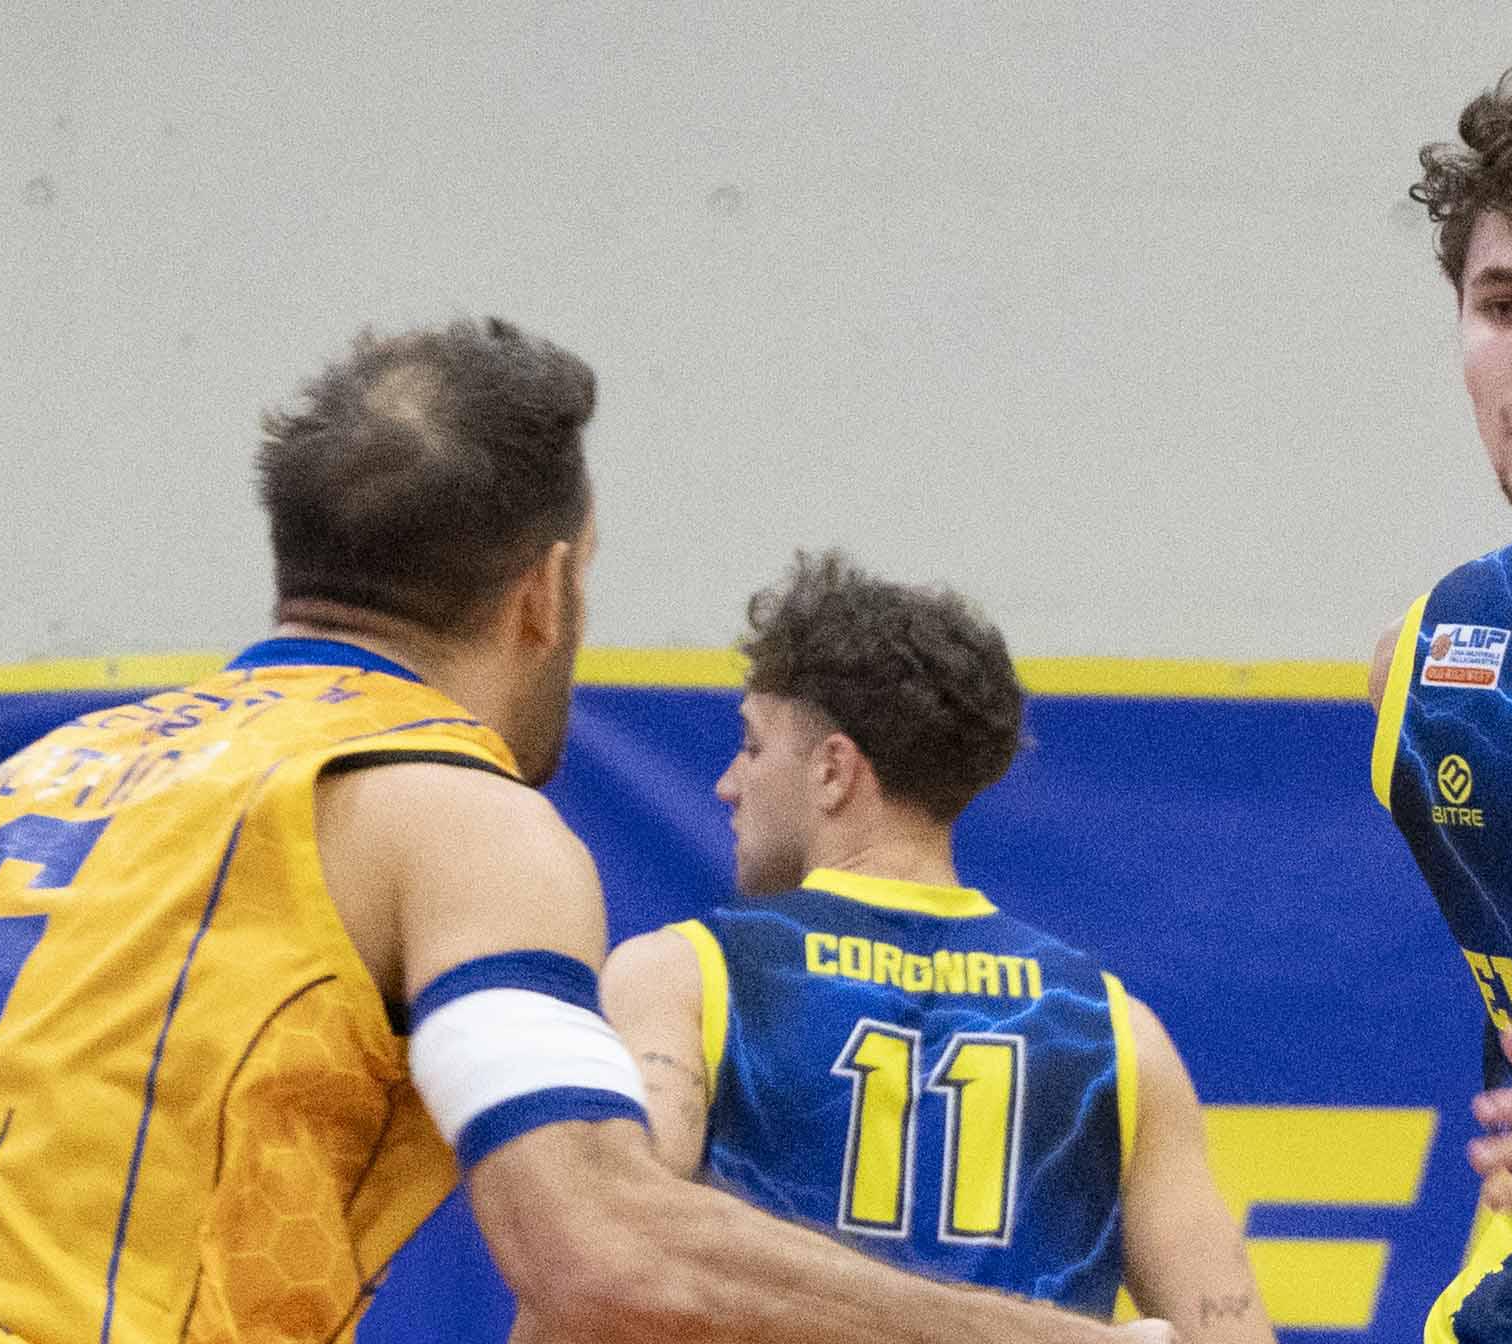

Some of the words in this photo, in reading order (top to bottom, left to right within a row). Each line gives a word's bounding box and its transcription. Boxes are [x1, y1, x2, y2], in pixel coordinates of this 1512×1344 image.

[1452, 626, 1506, 650] LNP
[1431, 805, 1485, 827] BITRE
[804, 931, 1043, 999] CORGNATI
[831, 1017, 1029, 1248] 11
